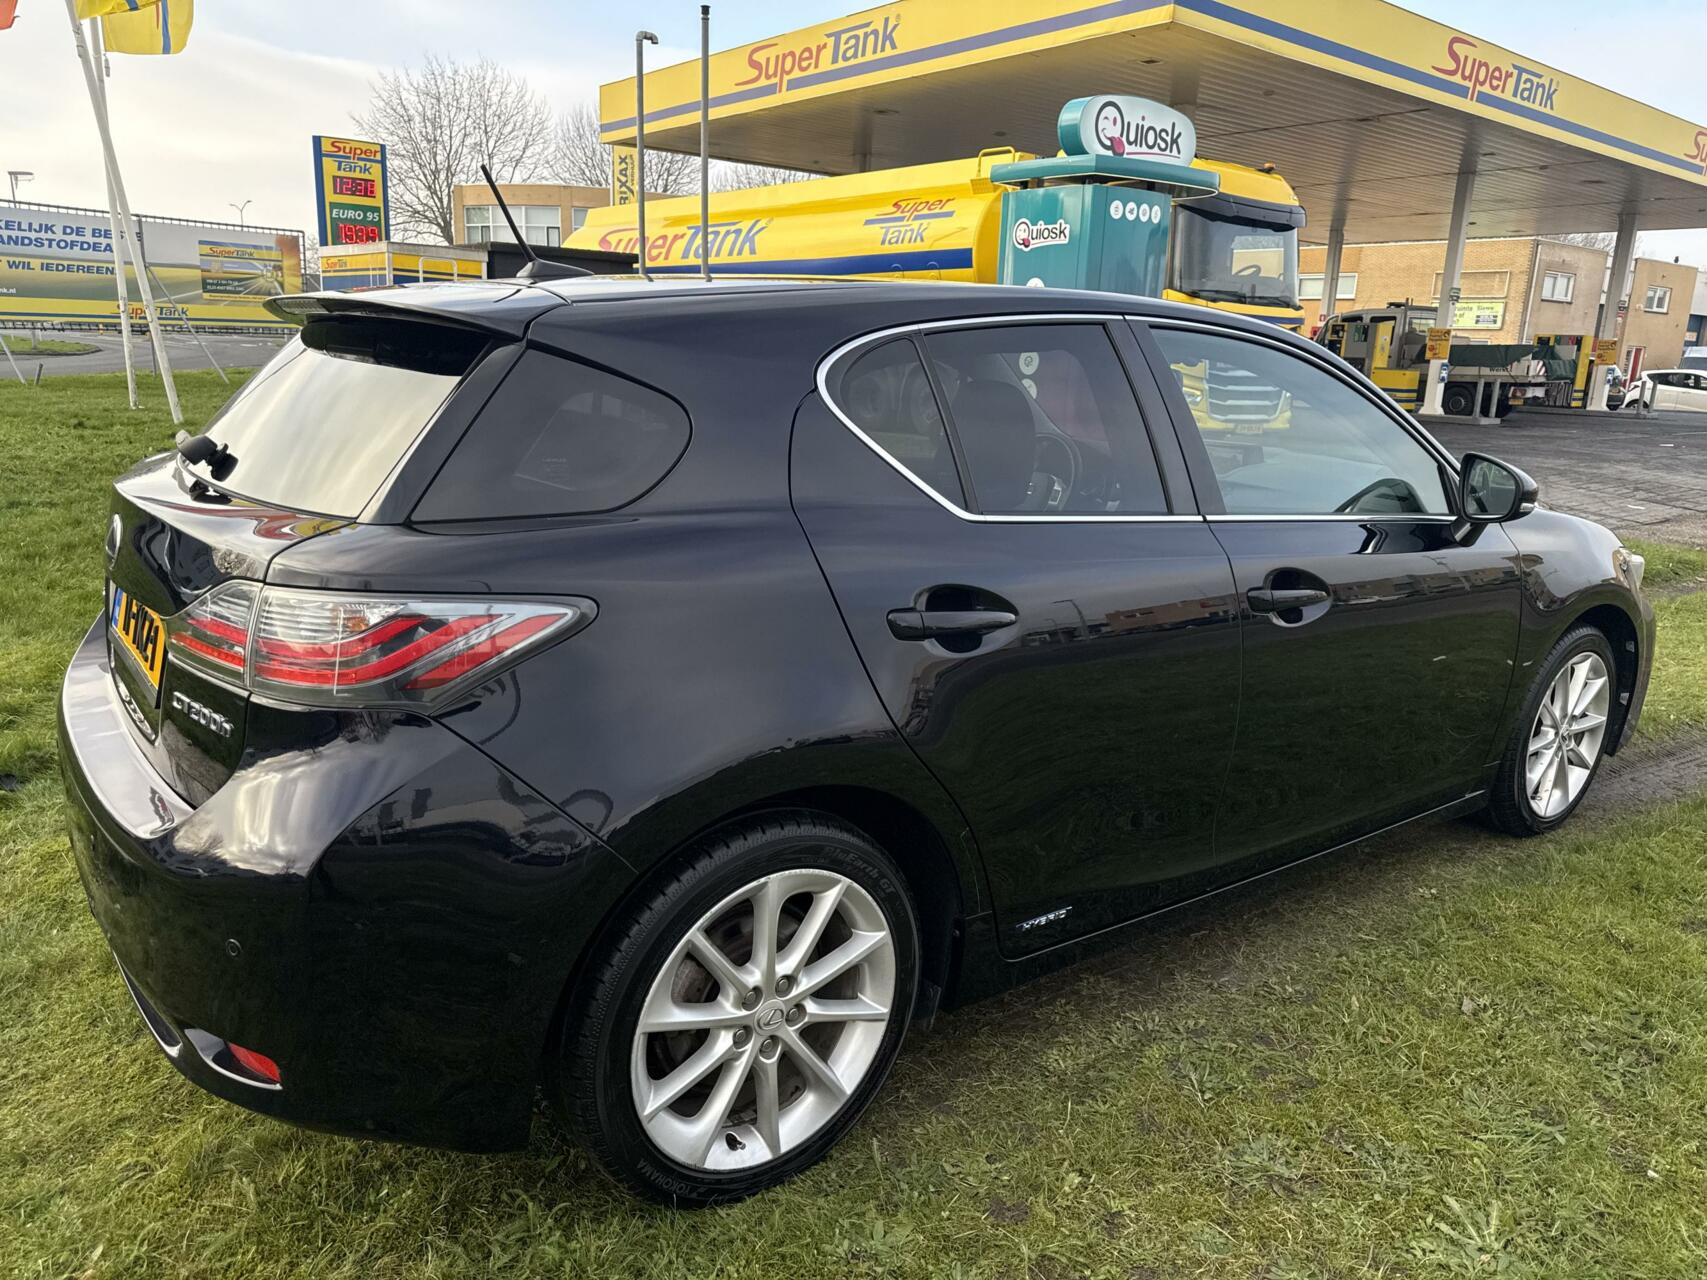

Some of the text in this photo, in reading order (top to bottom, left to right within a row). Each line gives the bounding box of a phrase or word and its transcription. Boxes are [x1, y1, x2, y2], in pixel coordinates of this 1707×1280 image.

[735, 16, 900, 93] SuperTank
[1431, 36, 1557, 111] SuperTank
[1095, 100, 1181, 156] Quiosk
[326, 140, 380, 160] Super
[1683, 131, 1707, 176] Su
[333, 160, 373, 175] Tank
[332, 208, 379, 221] EURO 95
[876, 197, 955, 221] Super
[62, 225, 86, 237] DE
[879, 222, 932, 247] Tank
[1014, 221, 1068, 248] Quiosk
[0, 234, 113, 253] ANDSTOFDEA
[208, 246, 255, 258] SuperTank
[7, 260, 115, 275] WIL IEDEREEN
